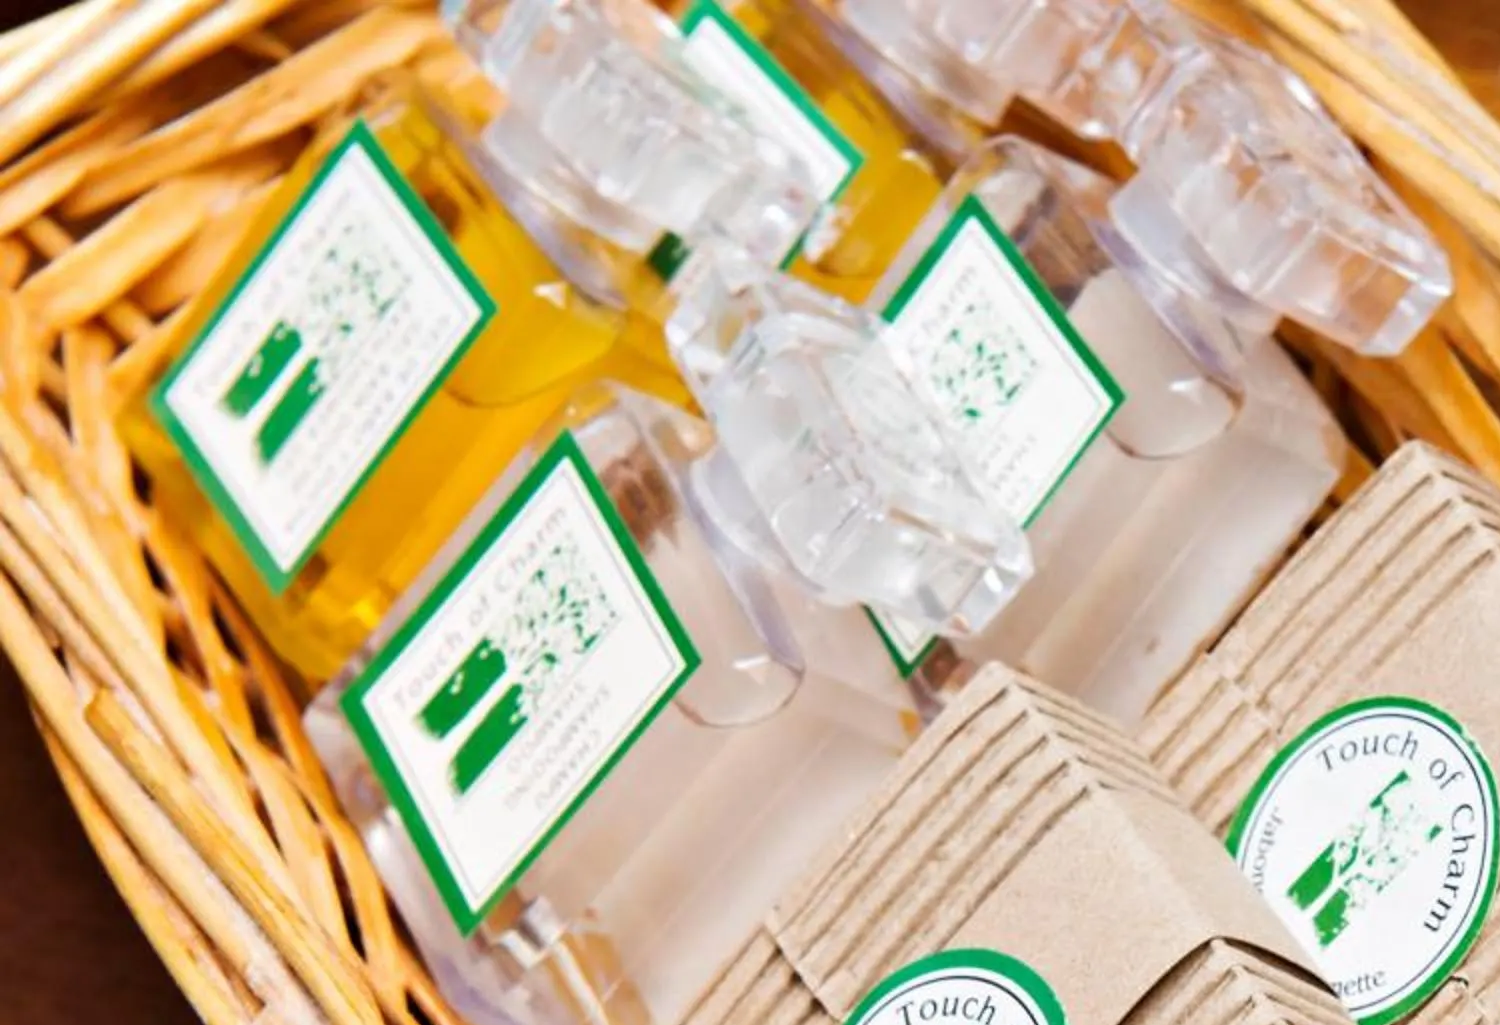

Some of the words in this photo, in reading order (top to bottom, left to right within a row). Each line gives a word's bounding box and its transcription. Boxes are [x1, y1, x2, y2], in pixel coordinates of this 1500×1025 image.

[392, 623, 464, 714] Touch
[463, 591, 492, 630] of
[489, 501, 567, 598] Charm
[1316, 730, 1419, 772] Touch
[1428, 757, 1465, 791] of
[1423, 803, 1476, 933] Charm
